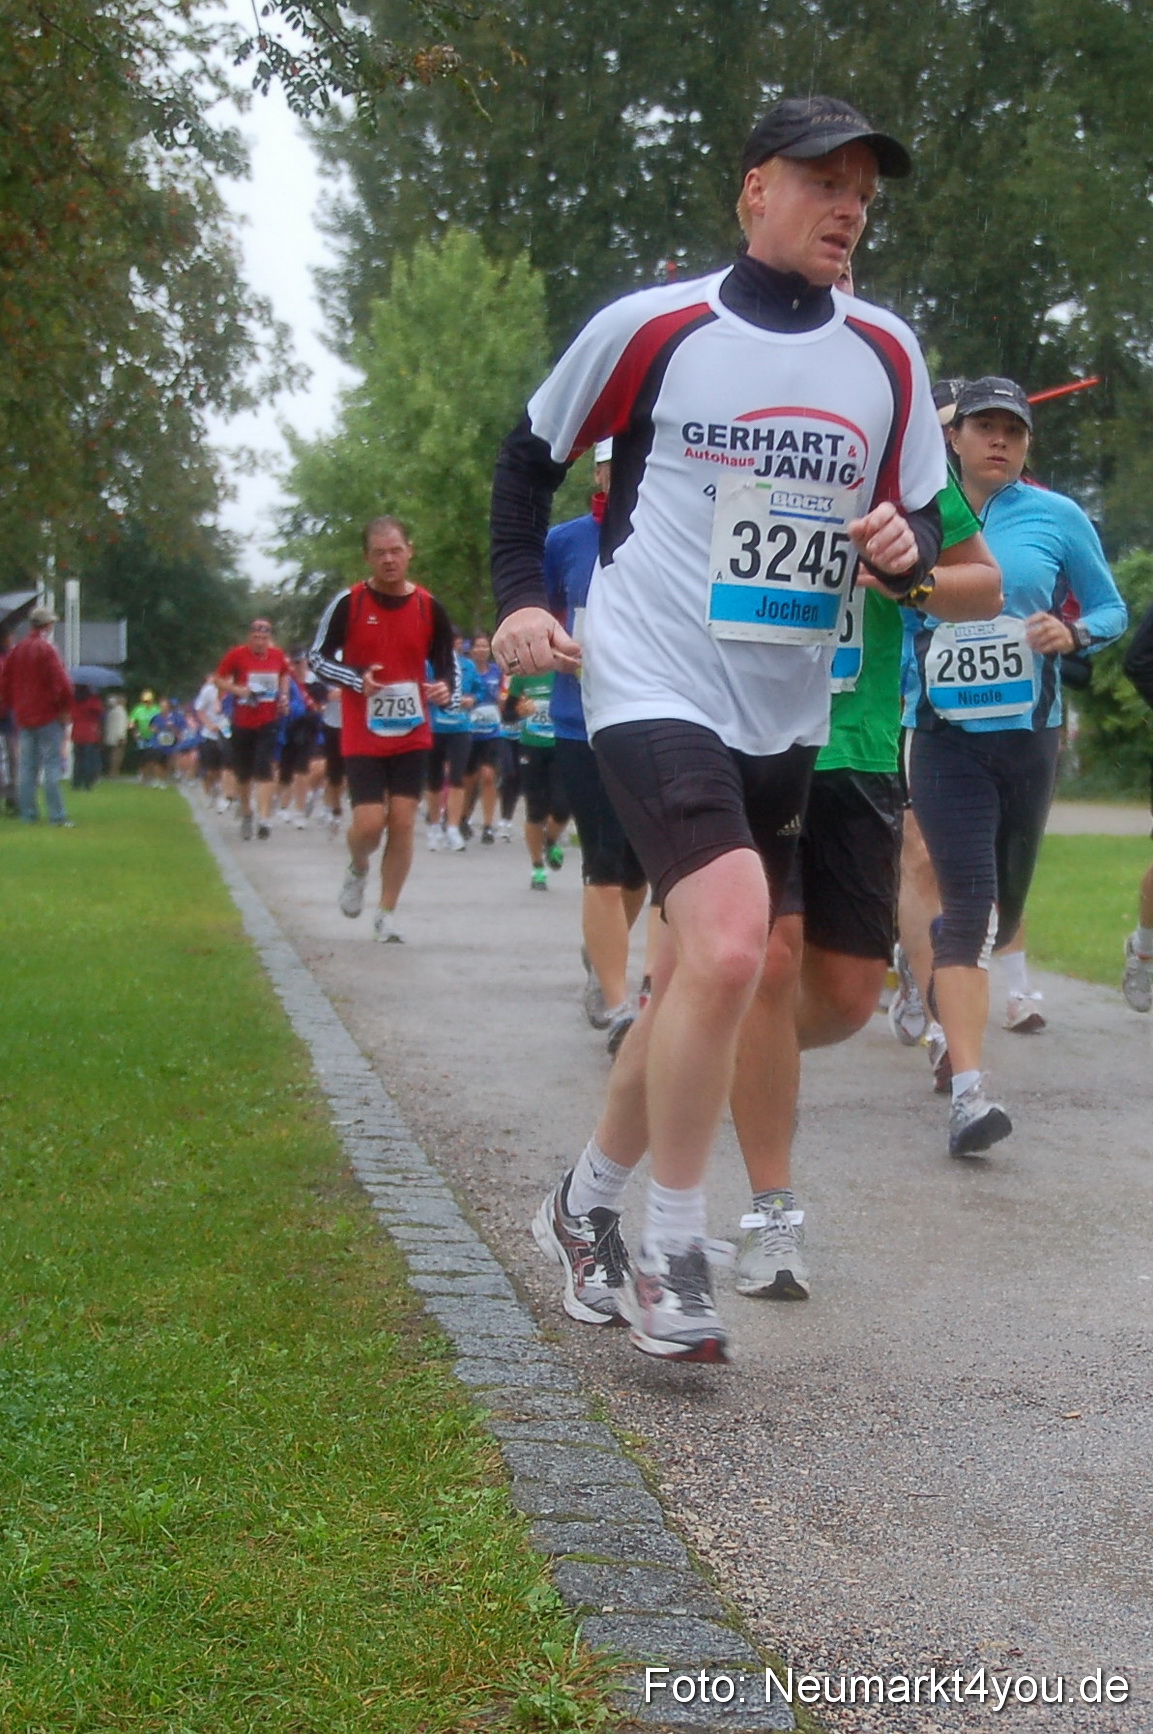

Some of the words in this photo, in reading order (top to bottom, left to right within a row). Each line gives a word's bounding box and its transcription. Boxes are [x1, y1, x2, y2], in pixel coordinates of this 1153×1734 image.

[682, 421, 845, 457] GERHART
[848, 444, 858, 458] &
[684, 446, 756, 468] Autohaus
[753, 454, 858, 486] JÄNIG
[770, 490, 834, 512] BOCK
[729, 520, 851, 589] 3245
[755, 595, 819, 622] Jochen
[936, 641, 1024, 683] 2855
[373, 696, 416, 717] 2793
[957, 688, 1002, 705] Nicole
